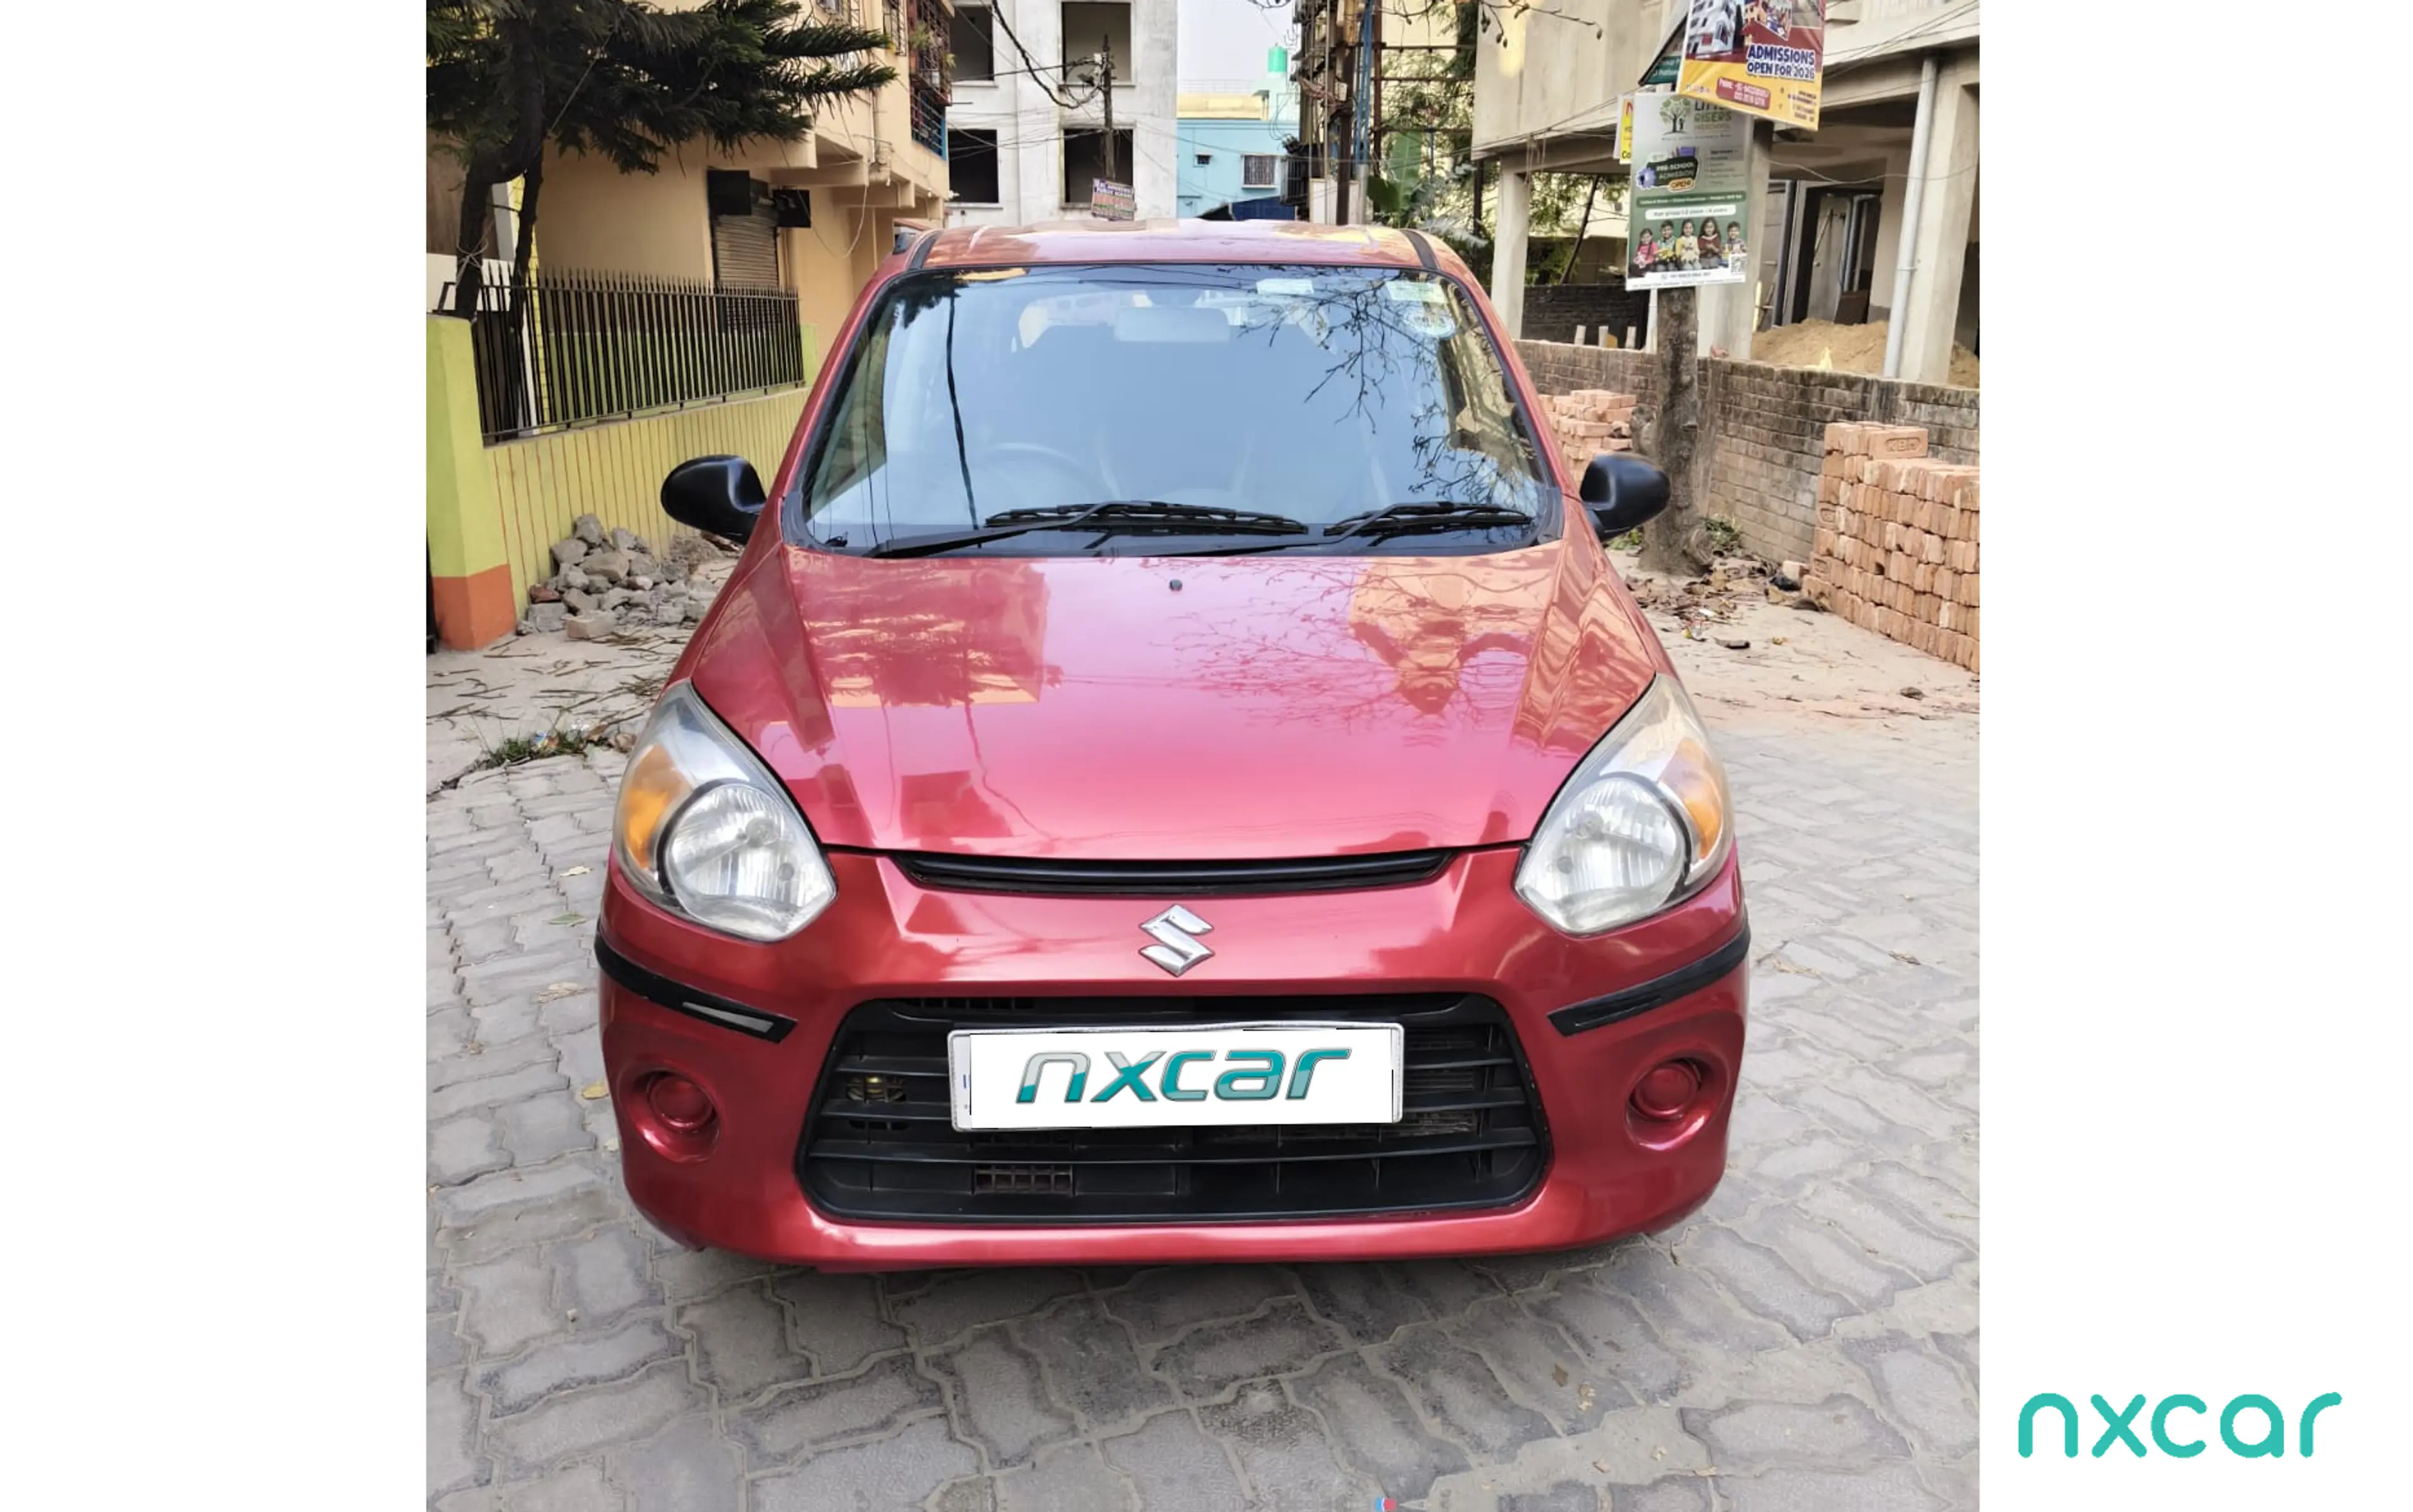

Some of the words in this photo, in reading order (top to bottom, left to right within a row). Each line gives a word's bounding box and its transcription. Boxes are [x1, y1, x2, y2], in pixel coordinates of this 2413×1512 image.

[1748, 45, 1814, 65] ADMISSIONS
[1748, 62, 1772, 74] OPEN
[1775, 64, 1792, 77] FOR
[1793, 66, 1815, 80] 2026
[1694, 111, 1732, 122] RISERS
